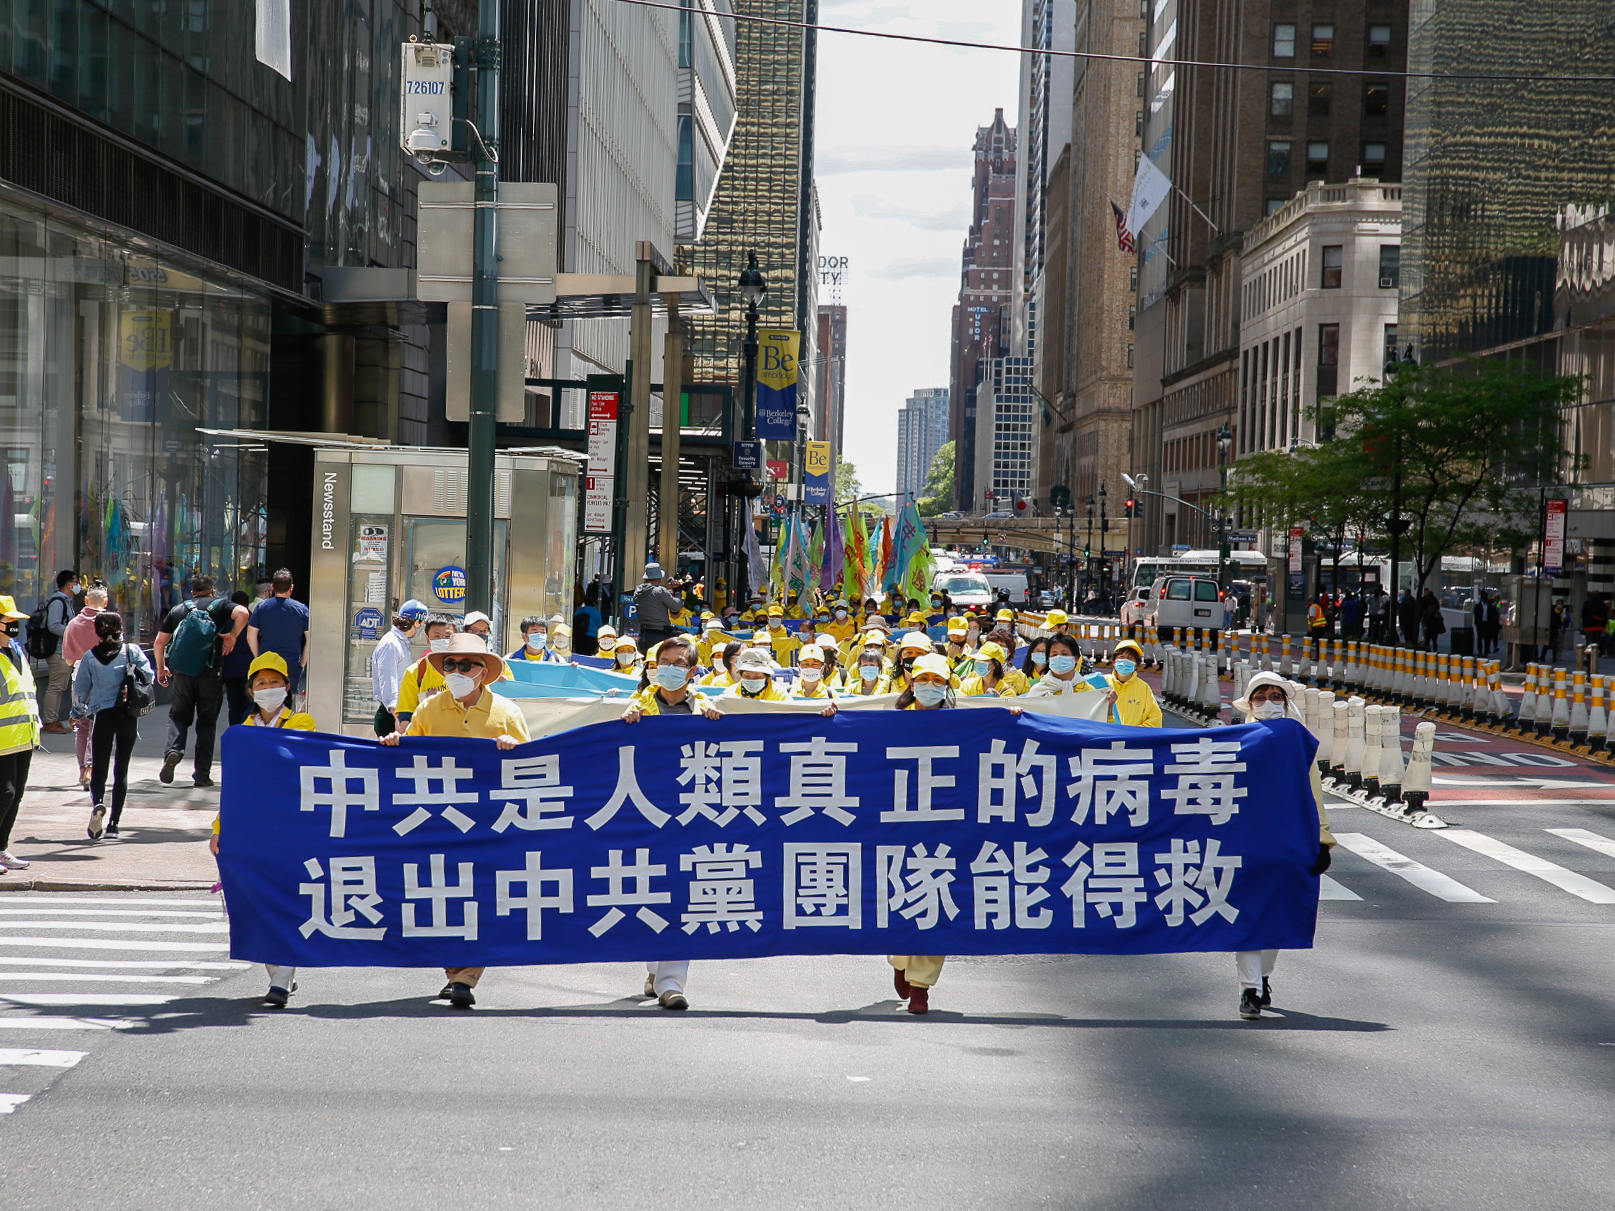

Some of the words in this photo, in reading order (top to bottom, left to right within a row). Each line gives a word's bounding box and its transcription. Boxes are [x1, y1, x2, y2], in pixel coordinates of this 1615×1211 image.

[406, 80, 445, 95] 726107
[761, 345, 794, 372] Be
[760, 371, 795, 380] ambitious
[766, 409, 794, 419] Berkeley
[766, 417, 792, 427] College
[809, 450, 827, 466] Be
[321, 472, 338, 550] Newsstand
[452, 578, 466, 587] YOR
[435, 587, 466, 599] LOTTER
[628, 605, 637, 618] P
[360, 617, 380, 629] ADT
[299, 736, 1248, 838] 中共是人類真正的病毒
[298, 838, 1243, 941] 退出中共黨團隊能得救
